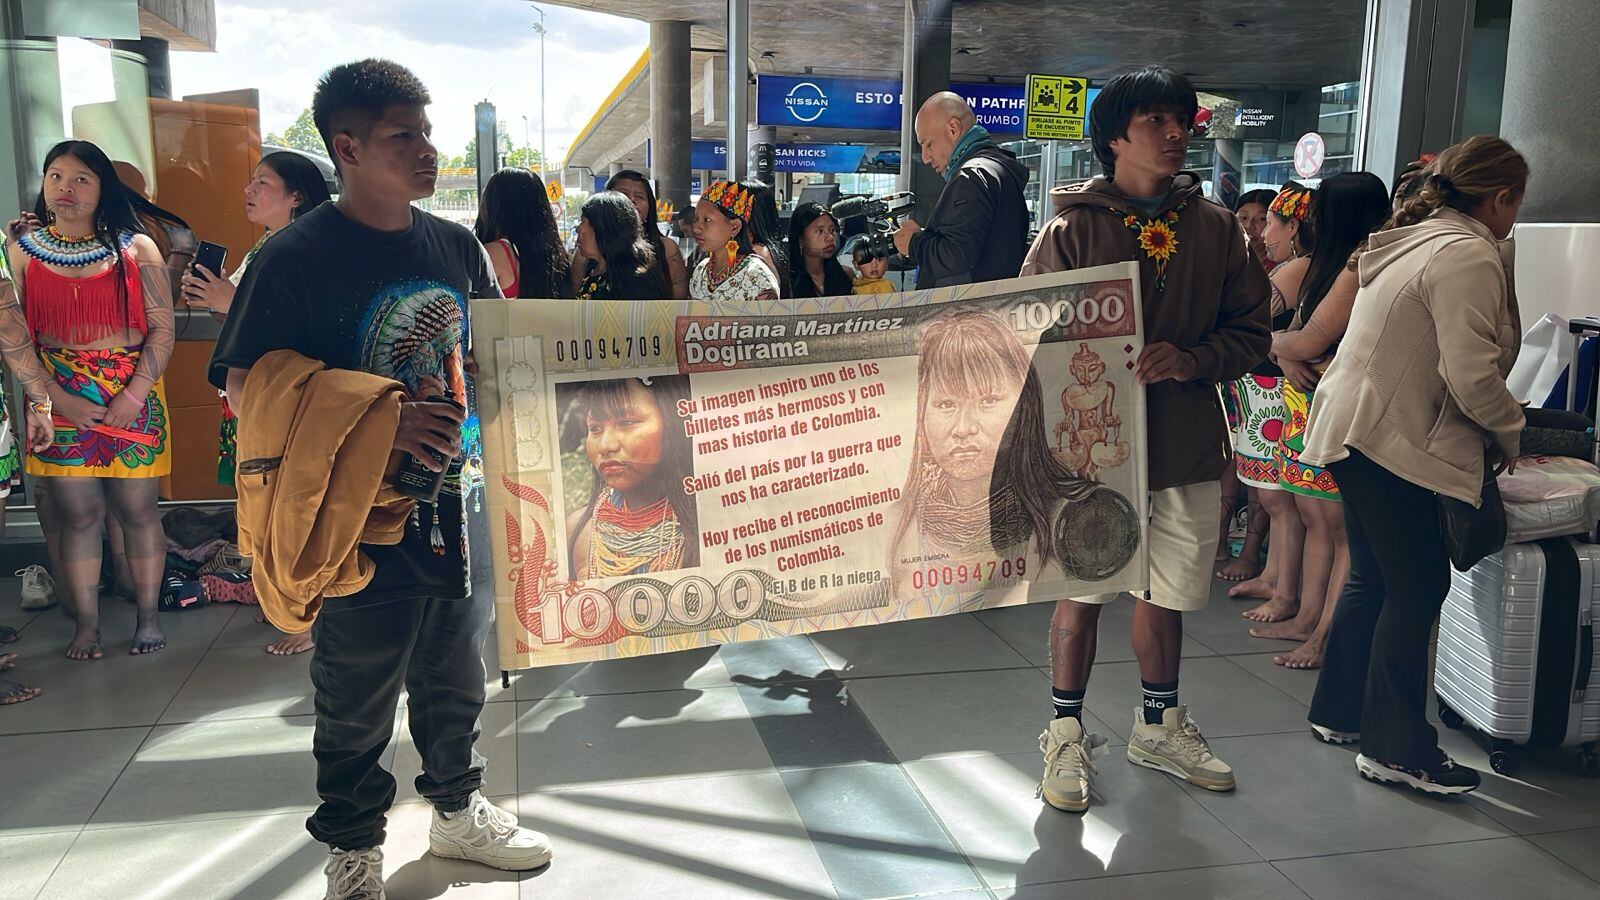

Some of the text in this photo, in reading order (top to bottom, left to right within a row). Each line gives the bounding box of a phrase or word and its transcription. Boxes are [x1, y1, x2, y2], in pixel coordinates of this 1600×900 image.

[785, 98, 828, 106] NISSAN
[856, 92, 893, 104] ESTO
[982, 97, 1026, 109] PATHF
[1066, 96, 1079, 114] 4
[976, 115, 1020, 125] RUMBO
[798, 149, 826, 157] KICKS
[1010, 295, 1125, 332] 10000
[684, 316, 904, 342] Adriana Martínez
[556, 336, 661, 362] 00094709
[686, 340, 809, 367] Dogirama
[677, 362, 880, 416] Su imagen inspiro uno de los
[685, 382, 886, 436] billetes más hermosos y con
[698, 406, 881, 455] mas historia de Colombia.
[683, 433, 902, 495] Salió del país por la guerra que
[721, 461, 869, 507] nos ha caracterizado.
[702, 487, 901, 548] Hoy recibe el reconocimiento
[724, 511, 884, 564] de los numismáticos de
[777, 544, 845, 573] Colombia.
[901, 553, 950, 564] MUJER EMBERA
[773, 570, 881, 595] El B de R la niega
[912, 557, 1026, 589] 00094709
[527, 569, 767, 645] 10000
[1144, 698, 1165, 709] alo
